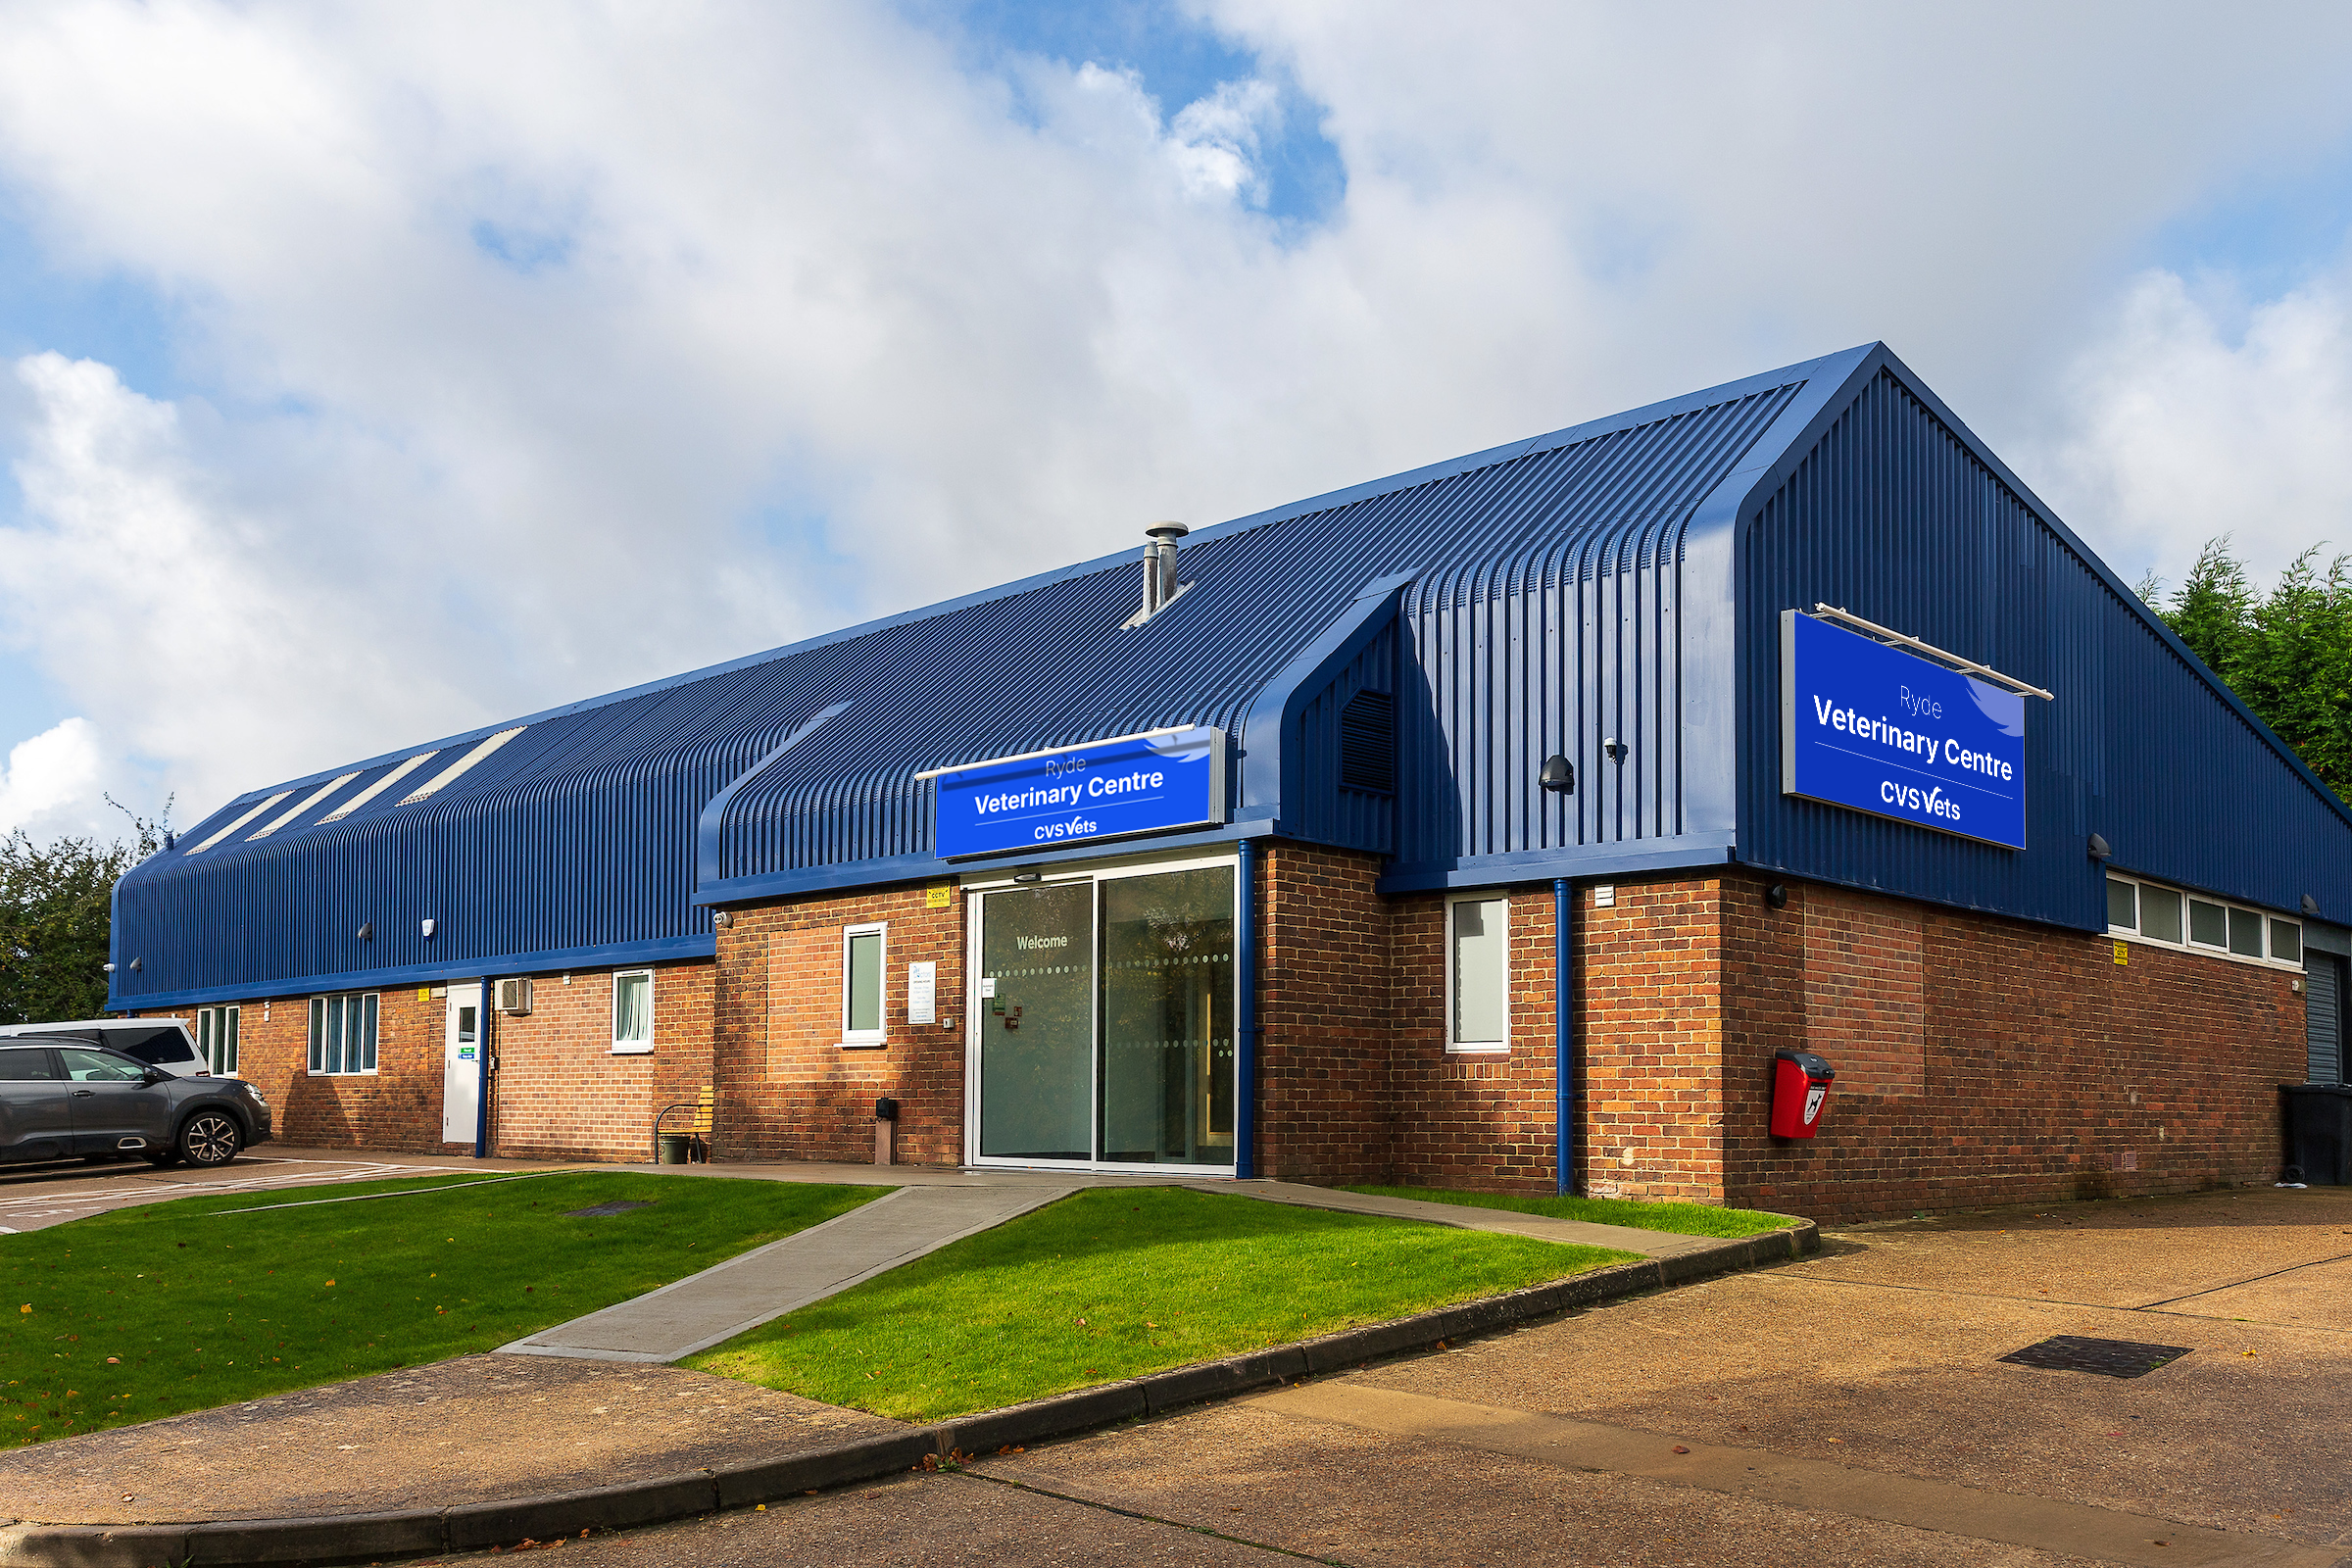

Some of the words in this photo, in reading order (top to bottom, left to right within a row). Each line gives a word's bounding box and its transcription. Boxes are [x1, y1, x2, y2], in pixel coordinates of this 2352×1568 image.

[1900, 684, 1942, 719] Ryde
[1813, 694, 1939, 764] Veterinary
[1944, 738, 2013, 781] Centre
[1045, 756, 1087, 780] Ryde
[974, 784, 1083, 814] Veterinary
[1088, 770, 1164, 797] Centre
[1016, 934, 1068, 951] Welcome
